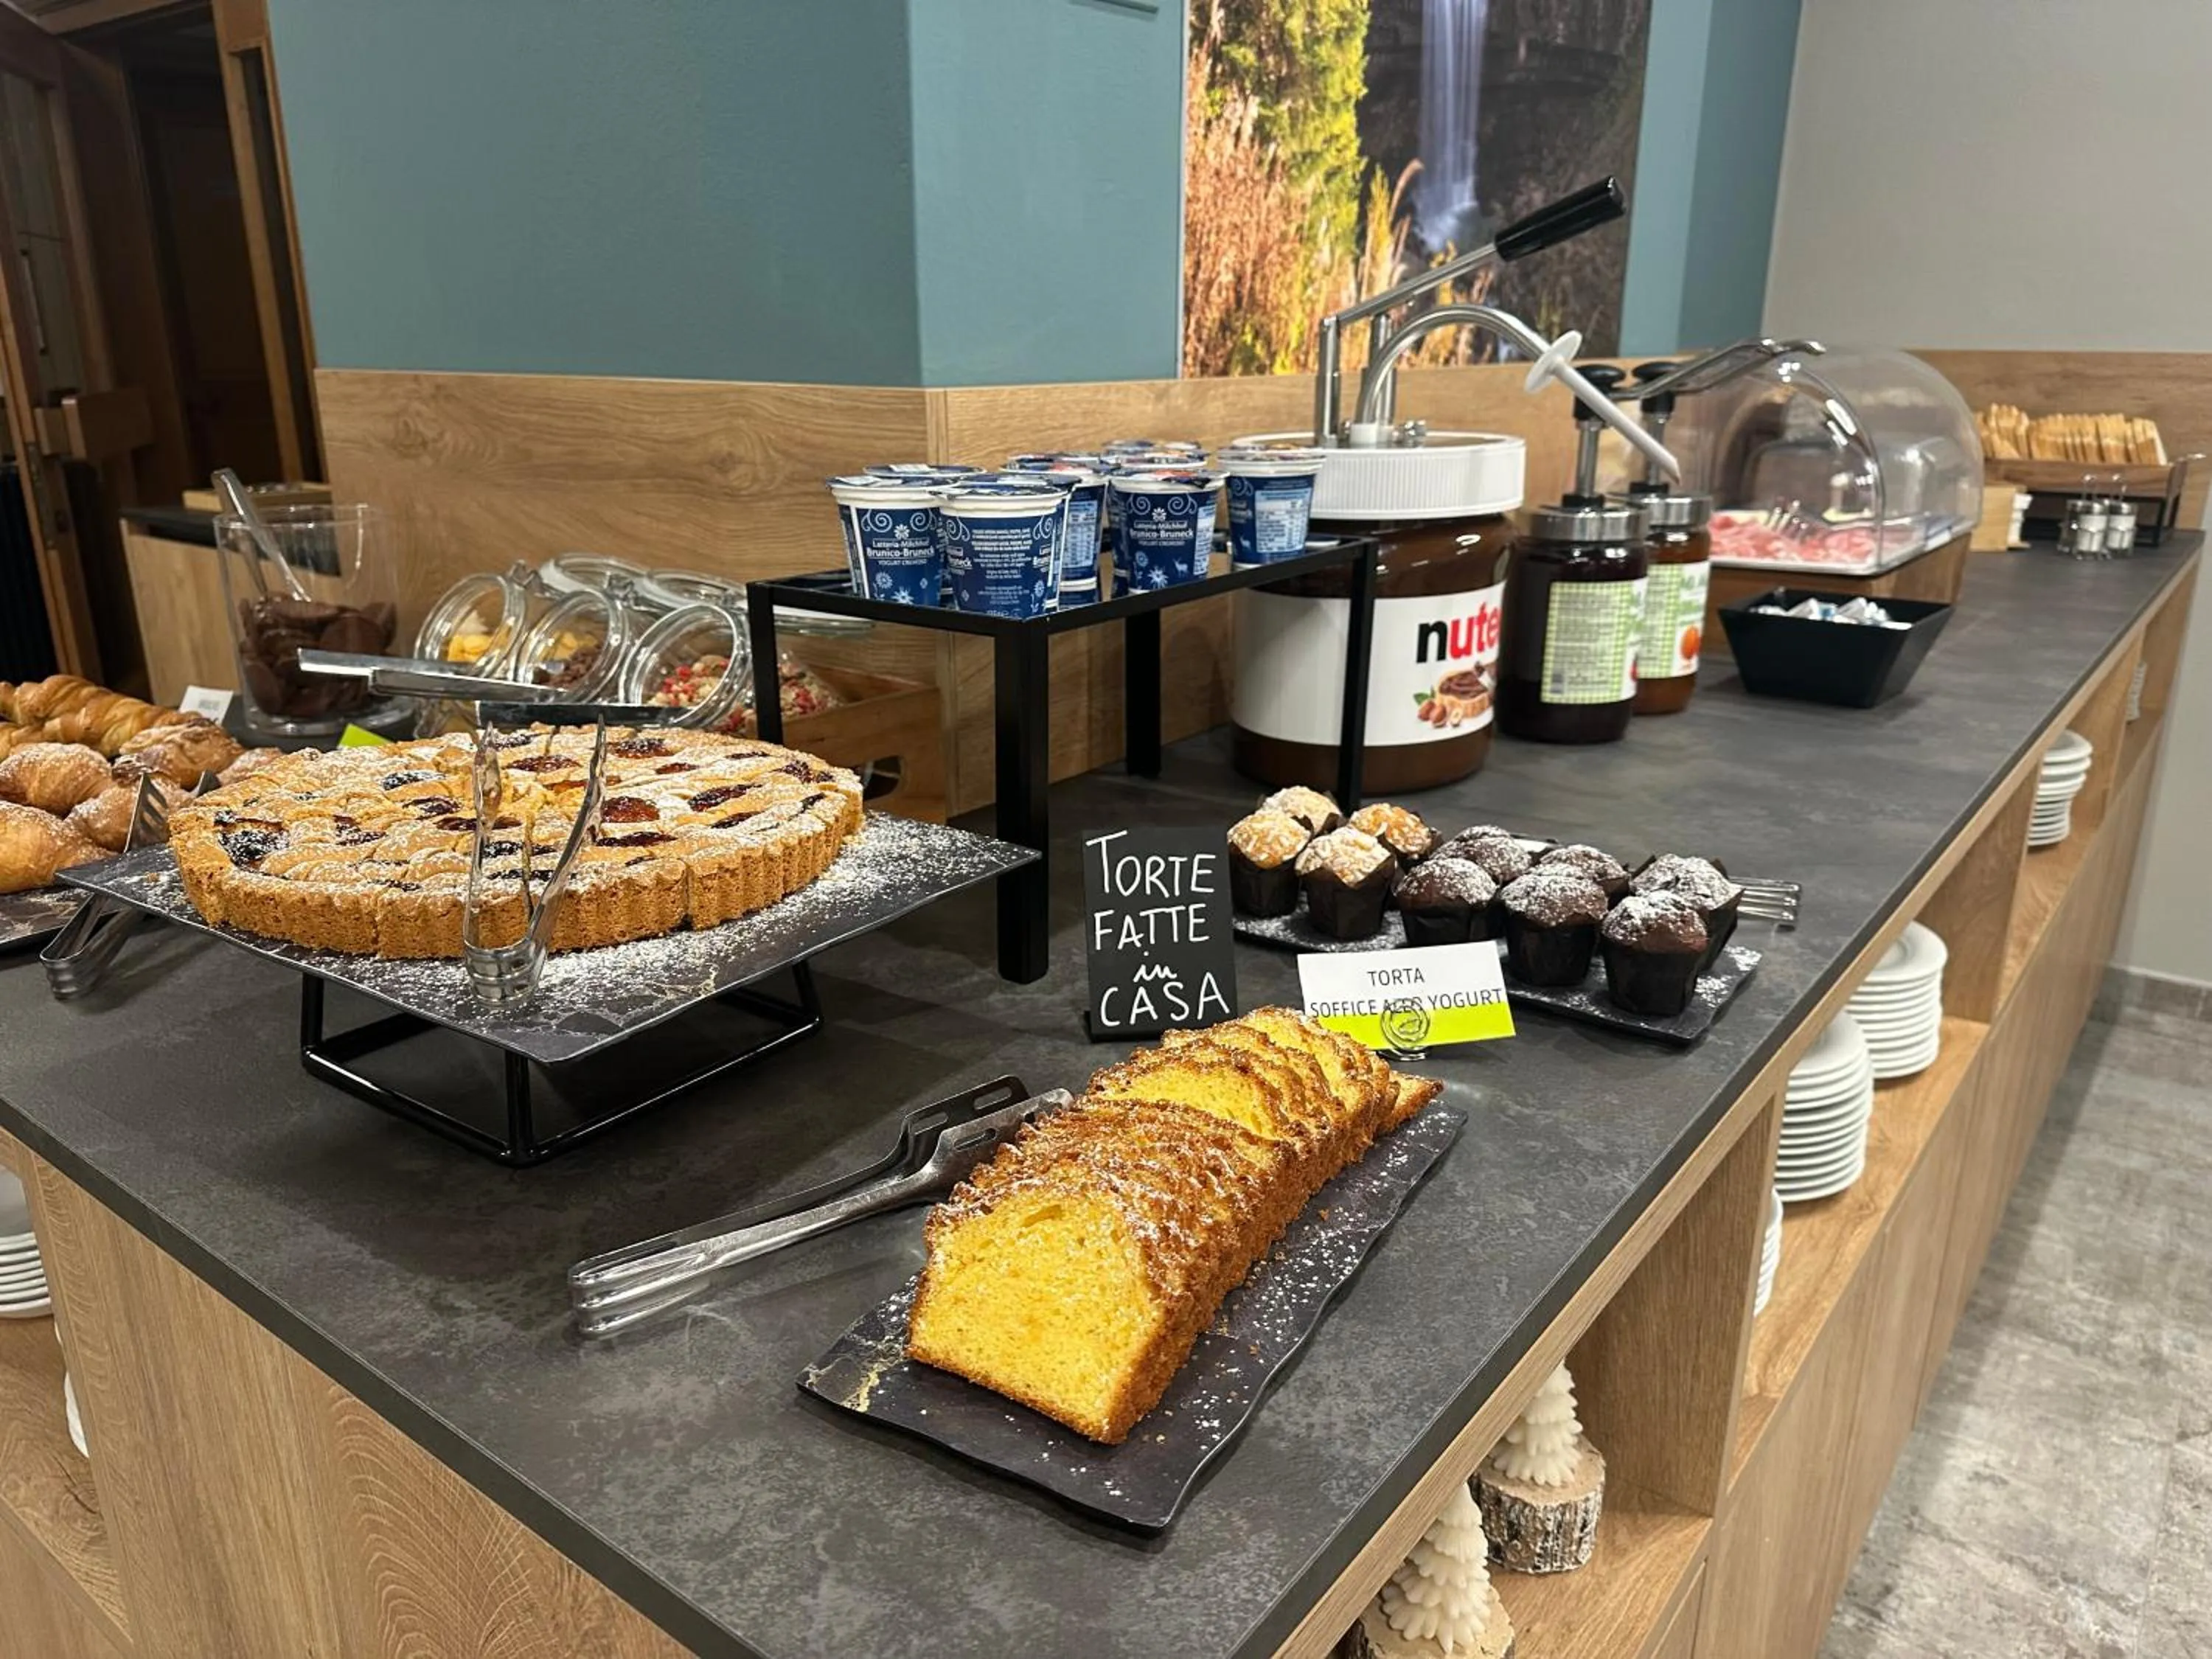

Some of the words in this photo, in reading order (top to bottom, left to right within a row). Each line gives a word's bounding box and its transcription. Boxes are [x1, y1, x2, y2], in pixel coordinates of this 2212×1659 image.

[1085, 830, 1217, 898] TORTE
[1094, 903, 1210, 950] FATTE
[1133, 951, 1178, 983] in
[1367, 967, 1425, 987] TORTA
[1100, 971, 1231, 1027] CASA
[1310, 999, 1378, 1018] SOFFICE
[1427, 988, 1502, 1011] YOGURT
